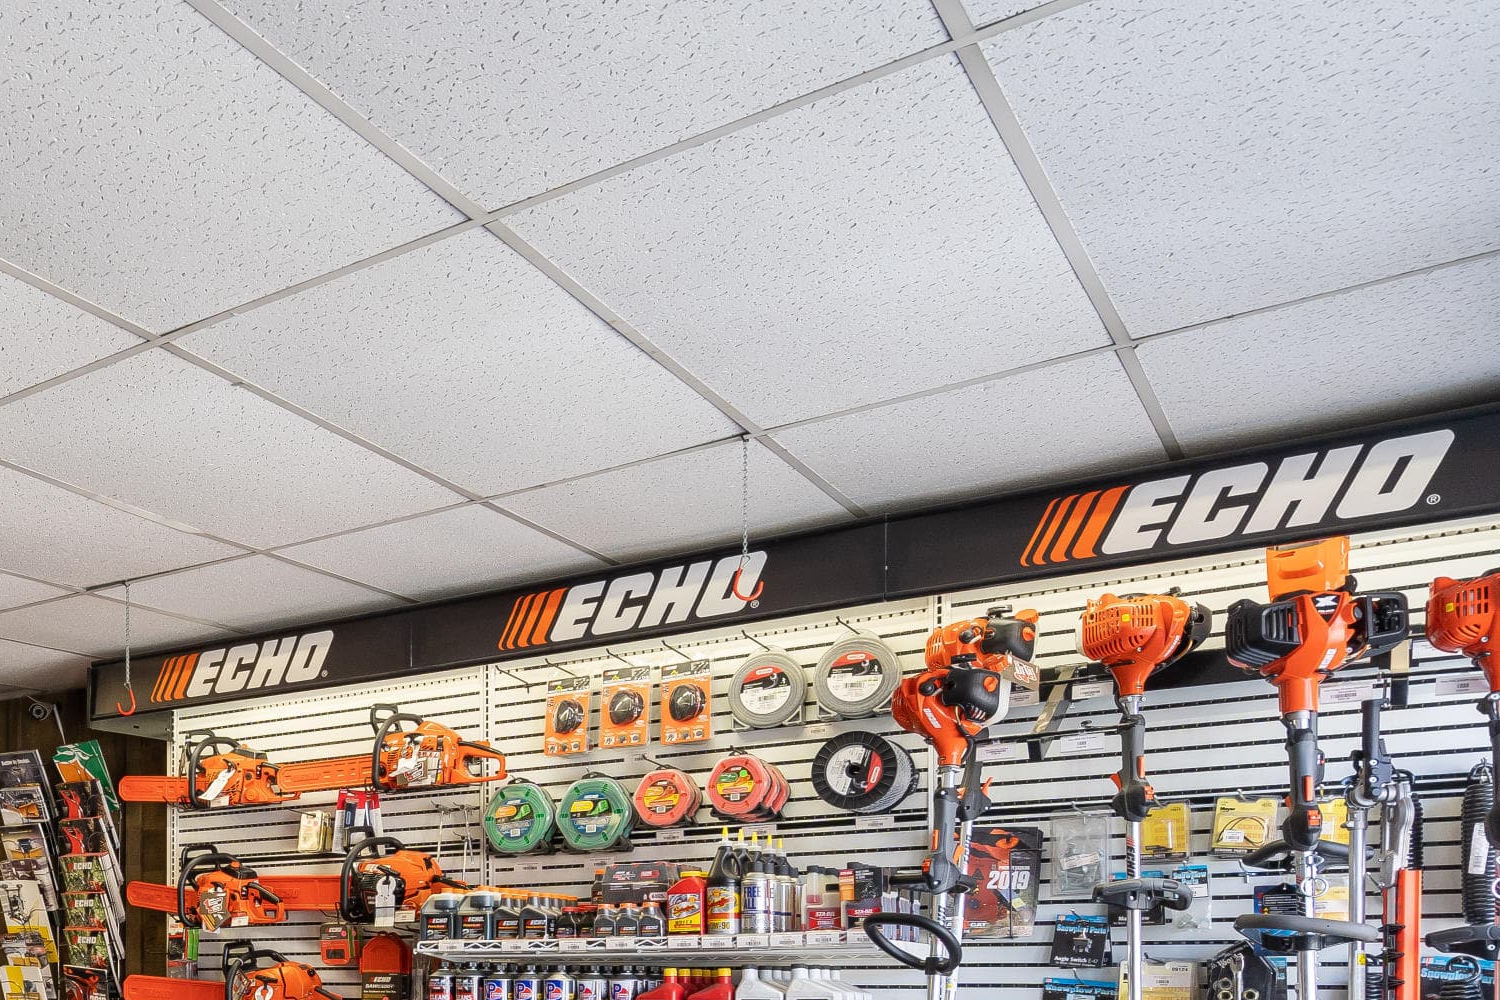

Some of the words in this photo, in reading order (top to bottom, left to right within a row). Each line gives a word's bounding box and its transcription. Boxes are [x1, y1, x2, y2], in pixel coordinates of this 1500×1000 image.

[1101, 429, 1454, 555] ECHO
[550, 551, 767, 642] ECHO
[187, 630, 333, 697] ECHO
[73, 862, 92, 870] ECHO
[986, 870, 1031, 890] 2019
[1056, 924, 1088, 933] Snowplow
[77, 936, 97, 944] ECHO
